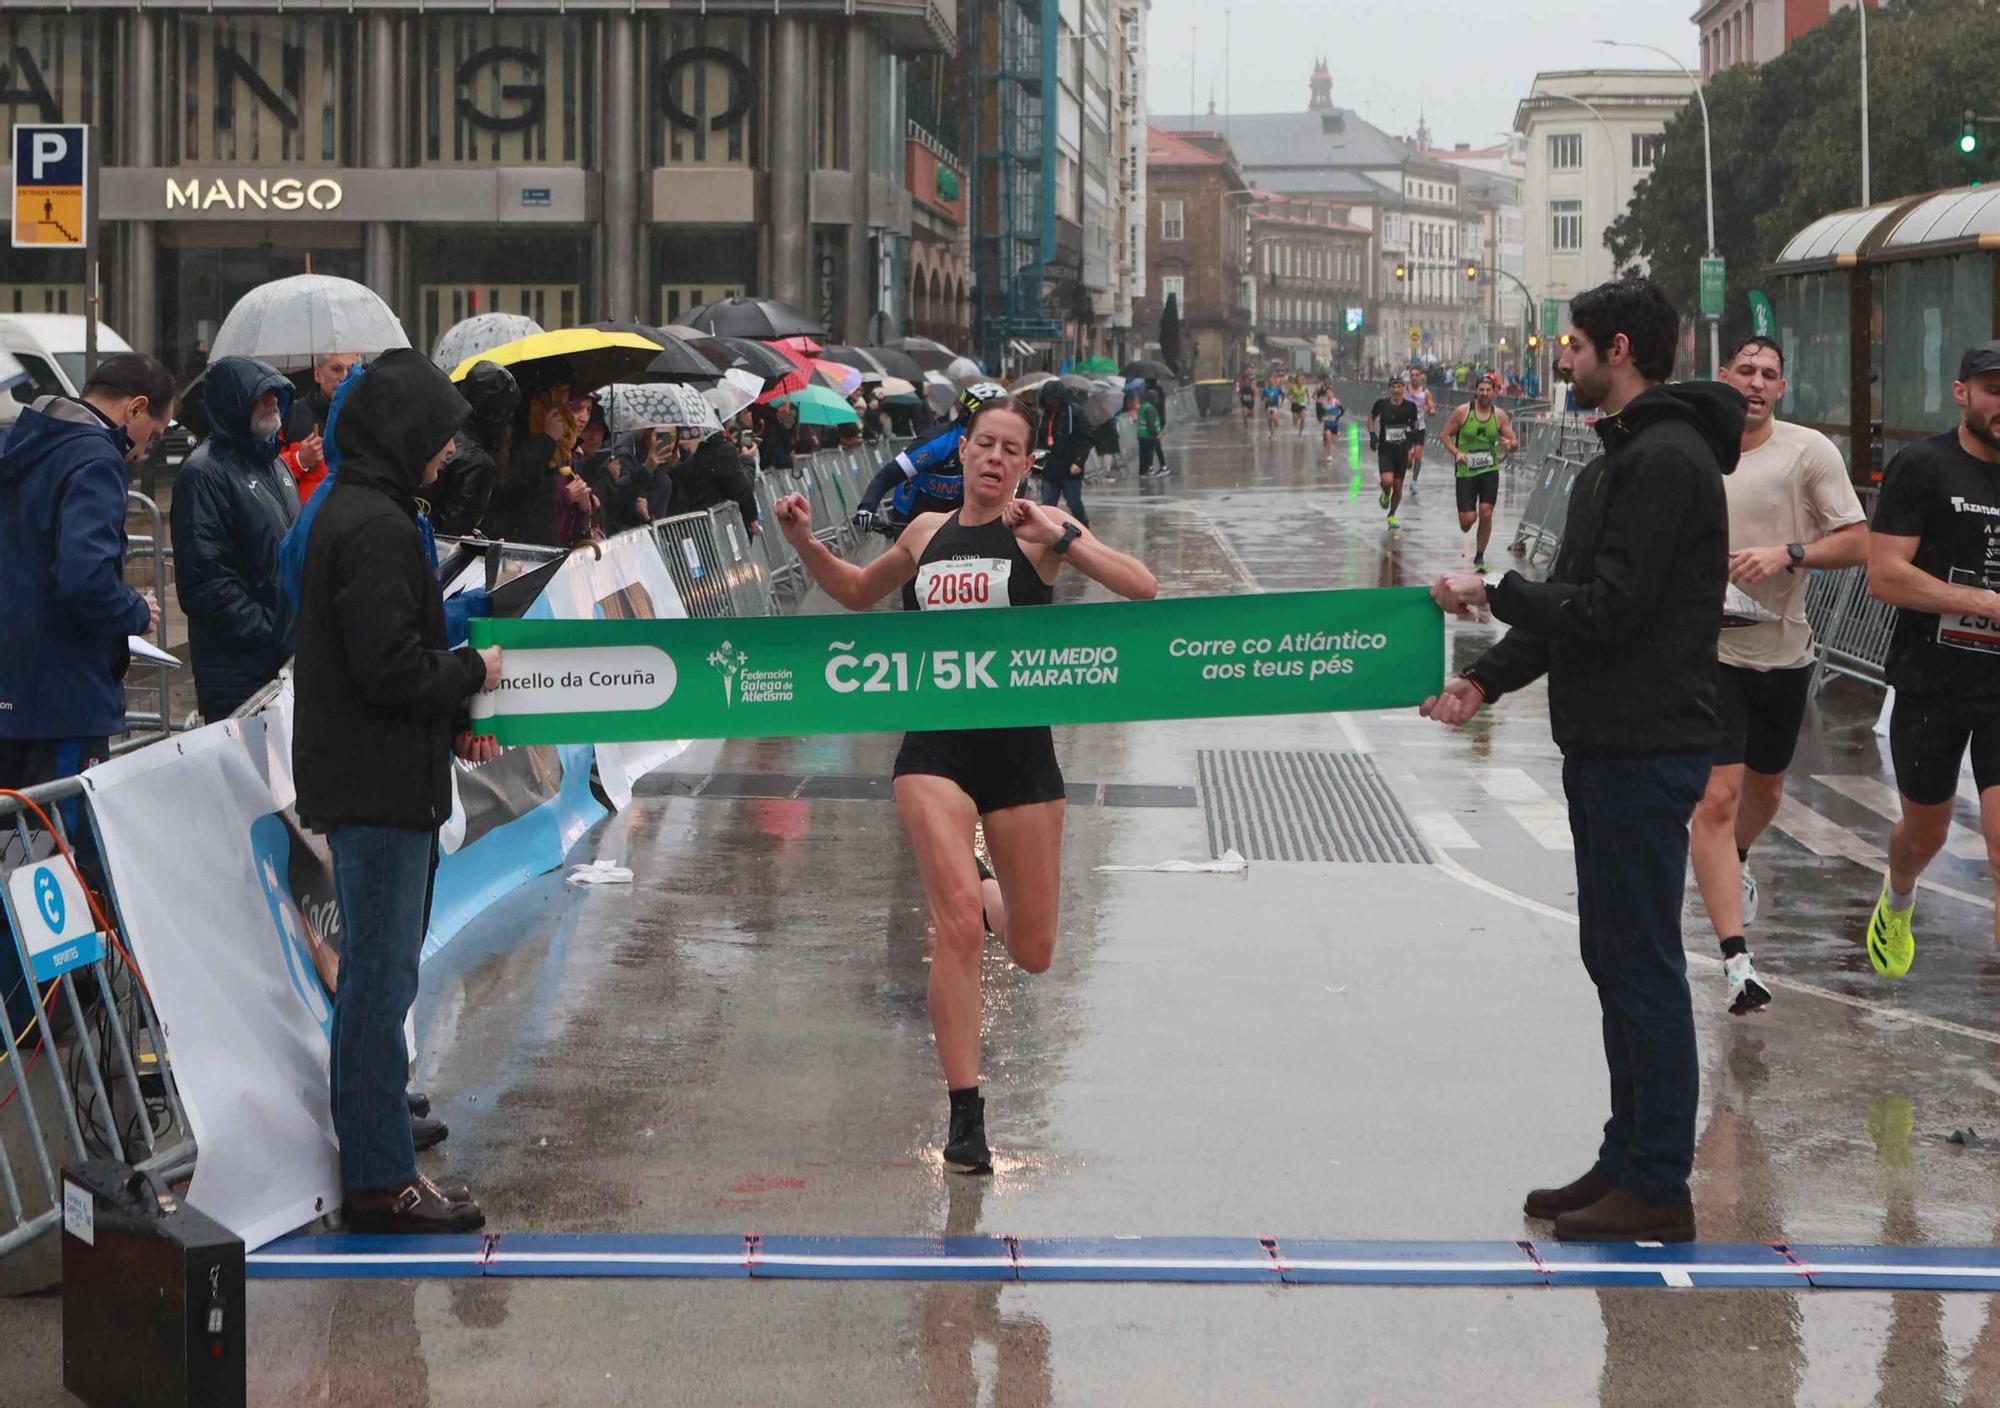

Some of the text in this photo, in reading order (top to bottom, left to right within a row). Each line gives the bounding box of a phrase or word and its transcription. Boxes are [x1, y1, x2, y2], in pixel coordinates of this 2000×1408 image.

[32, 133, 68, 180] P
[166, 178, 342, 210] MANGO
[927, 572, 990, 605] 2050
[1169, 629, 1387, 657] Corre co Atlántico
[1009, 646, 1118, 667] XVI MEDIO
[1202, 654, 1354, 681] aos teus pés
[487, 670, 656, 692] ncello da Coruña
[740, 668, 793, 680] Federación
[1010, 666, 1119, 687] MARATÓN
[741, 679, 793, 693] Galega de
[741, 691, 793, 702] Atletismo
